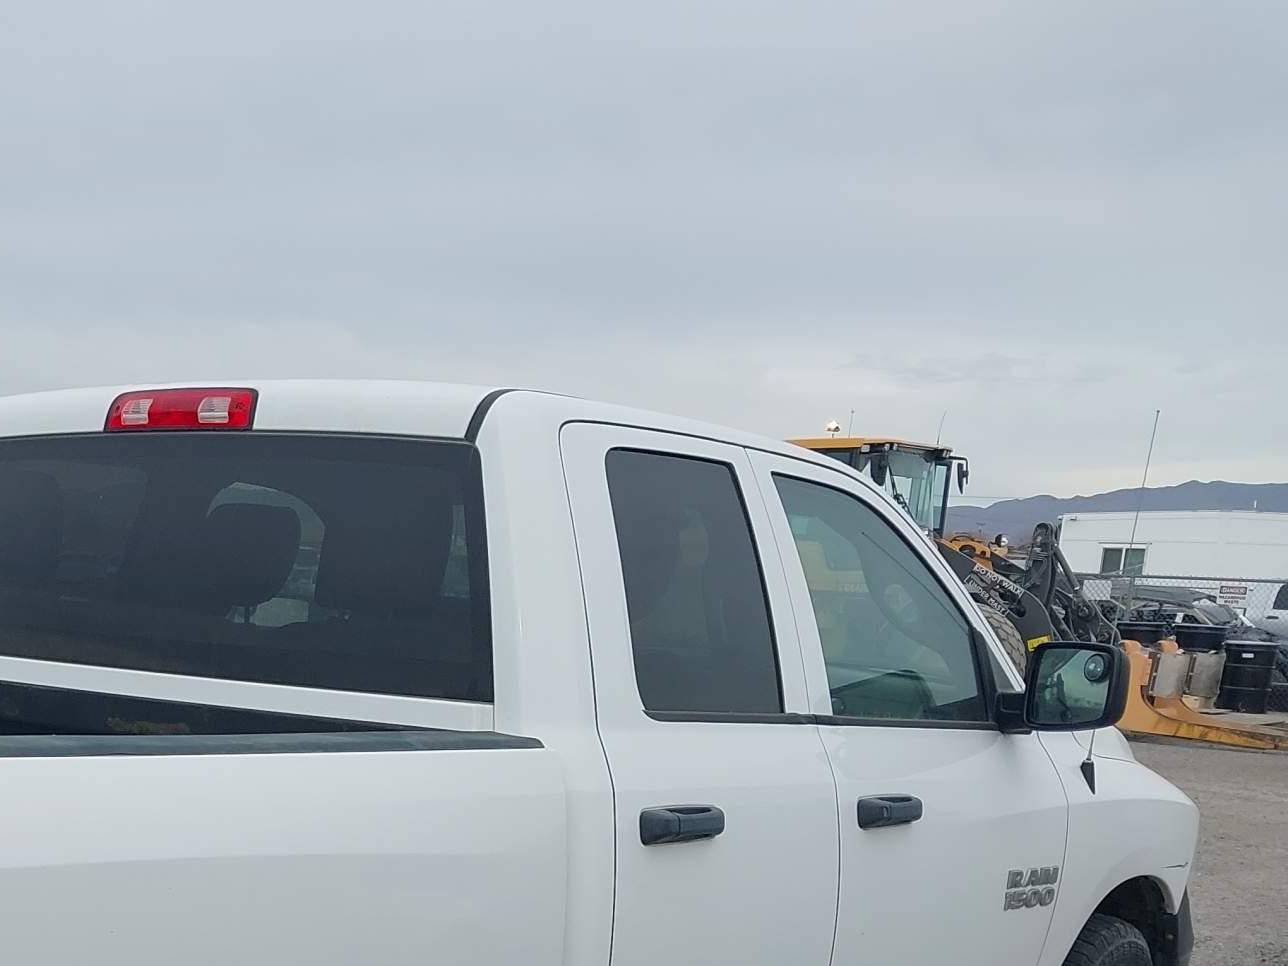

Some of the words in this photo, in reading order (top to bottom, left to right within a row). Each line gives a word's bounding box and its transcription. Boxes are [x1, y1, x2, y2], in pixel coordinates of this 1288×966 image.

[1002, 581, 1021, 596] WALK
[1007, 867, 1059, 889] RAM
[1004, 888, 1055, 911] 1500
